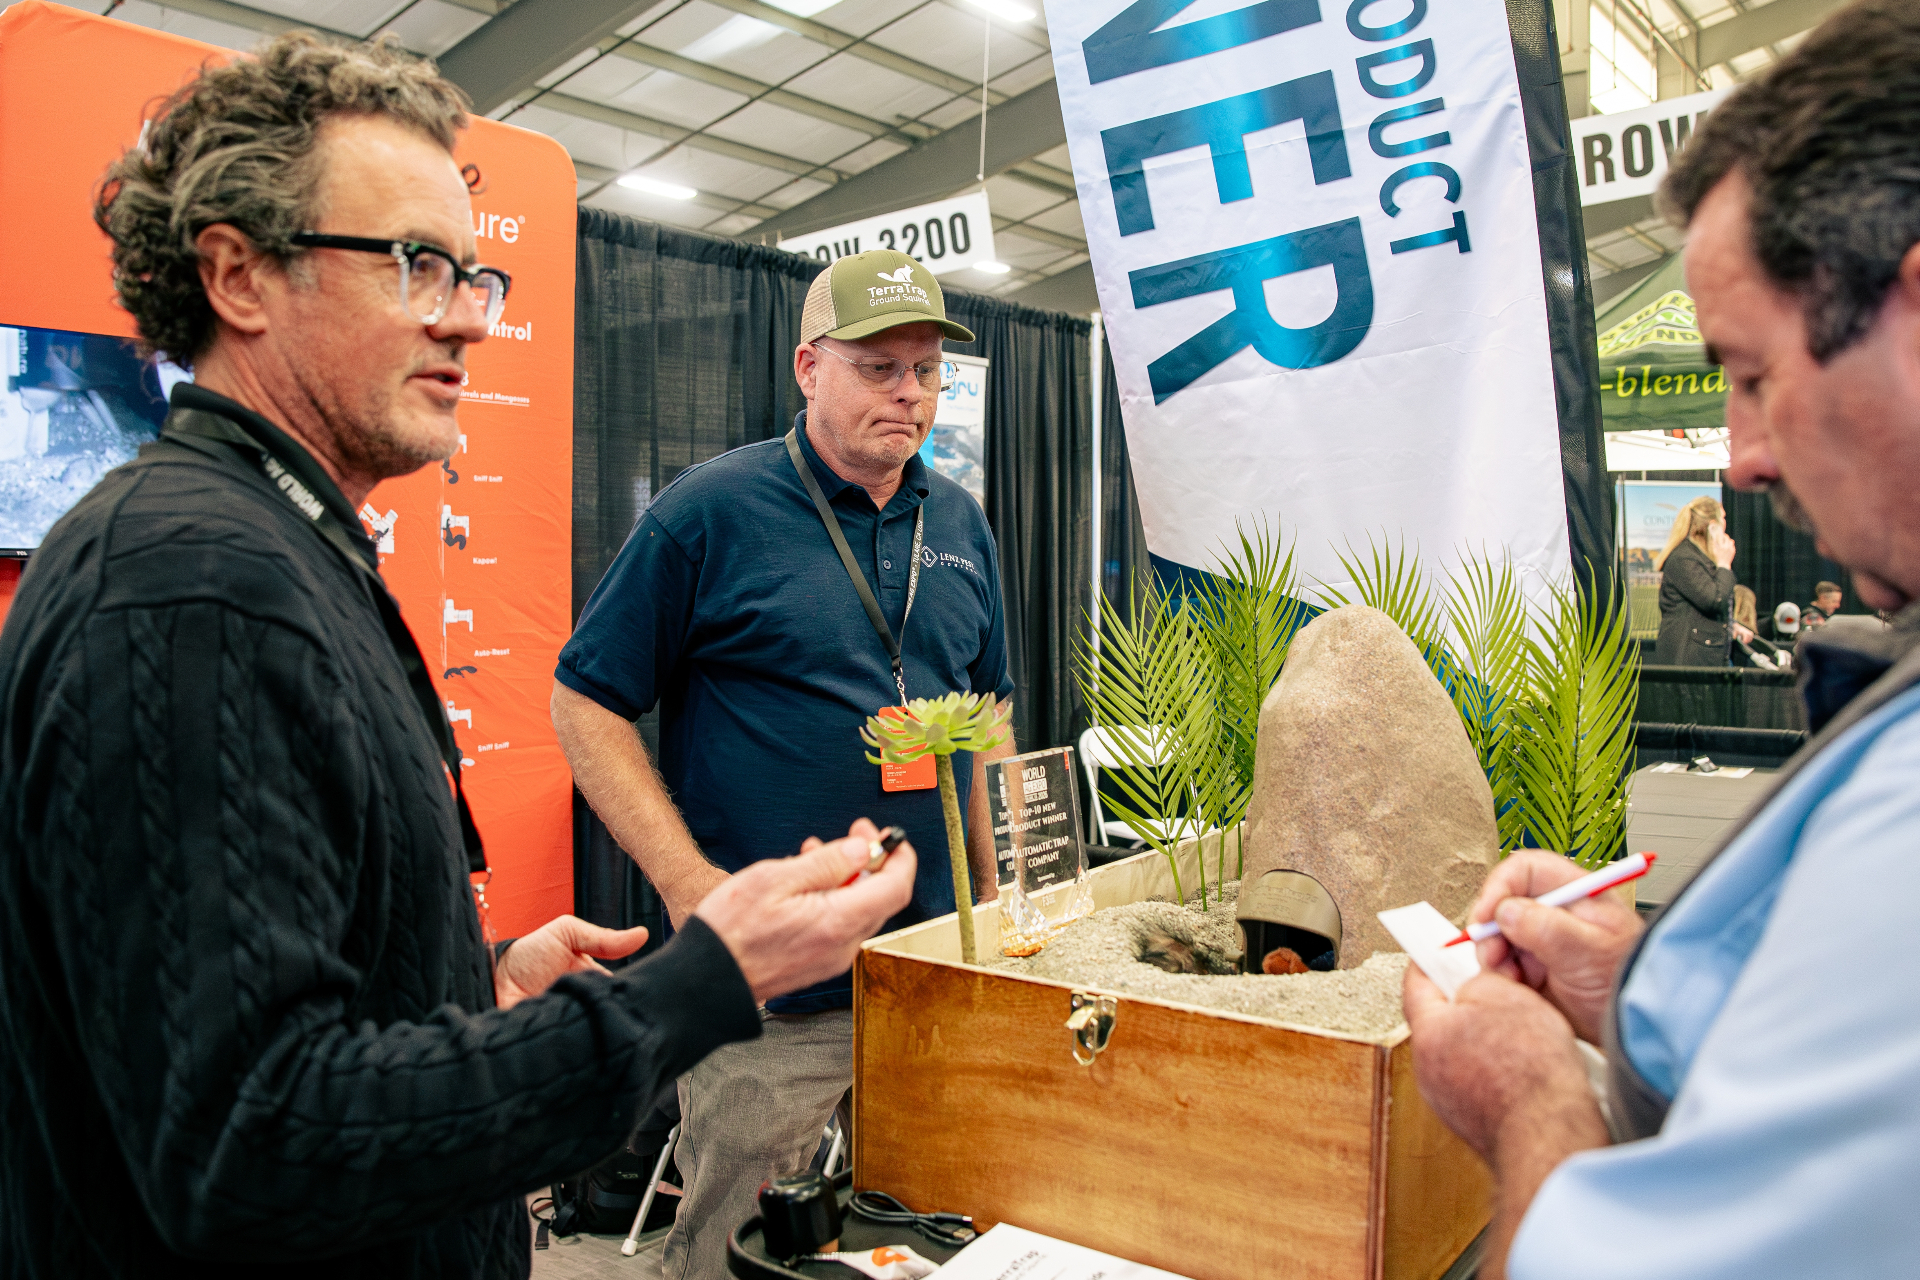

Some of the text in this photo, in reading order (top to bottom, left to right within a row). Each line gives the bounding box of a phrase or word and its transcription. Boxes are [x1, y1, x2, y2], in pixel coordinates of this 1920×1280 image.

[1346, 0, 1471, 255] ODUCT
[879, 212, 971, 263] 3200
[867, 283, 928, 299] TerraTrap
[869, 294, 901, 307] Ground
[277, 473, 325, 521] WORLD
[472, 556, 498, 565] Kapow!
[474, 648, 510, 657] Auto-Reset
[477, 741, 510, 753] Sniff Sniff
[1021, 765, 1046, 782] WORLD
[1019, 801, 1057, 819] TOP-10 NEW
[1042, 811, 1068, 826] WINNER
[1053, 835, 1070, 849] TRAP
[1027, 850, 1060, 869] COMPANY
